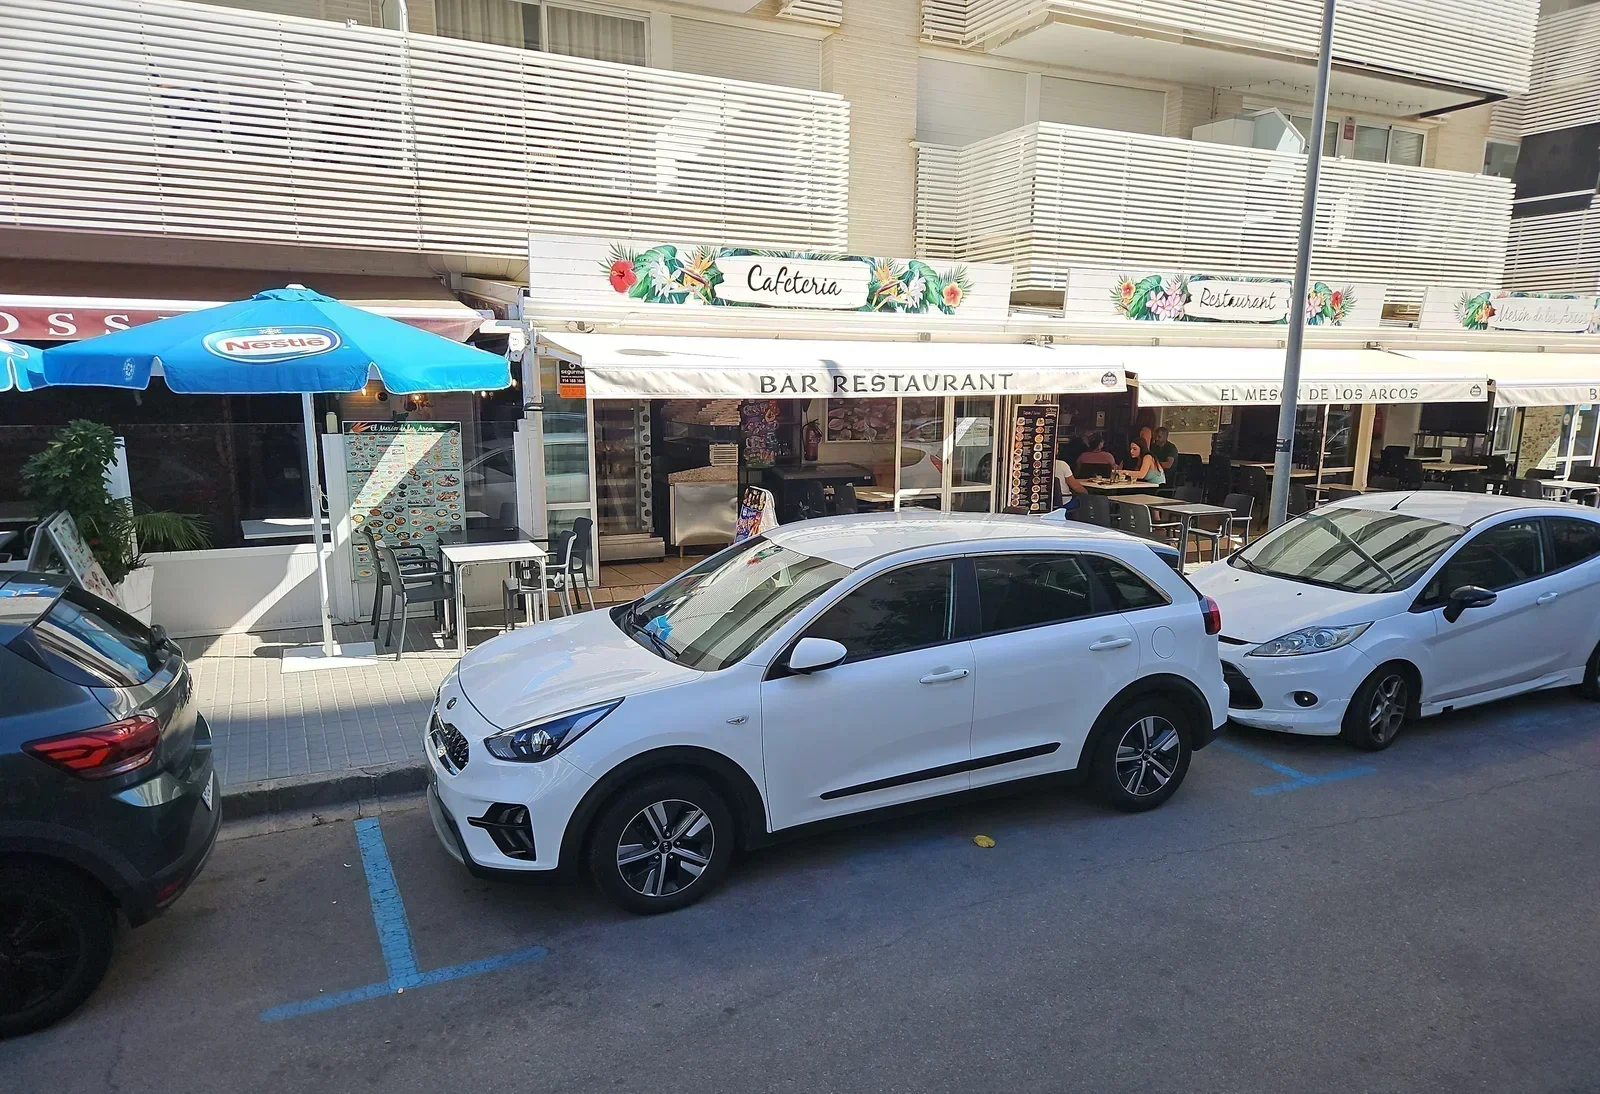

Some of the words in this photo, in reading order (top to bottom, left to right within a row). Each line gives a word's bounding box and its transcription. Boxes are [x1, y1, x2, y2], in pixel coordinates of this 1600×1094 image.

[747, 264, 842, 296] Cafeteria
[1199, 287, 1276, 310] Restaurant
[759, 375, 818, 394] BAR
[832, 372, 1014, 394] RESTAURANT
[1220, 388, 1239, 401] EL
[1309, 387, 1329, 400] DE
[1335, 387, 1363, 400] LOS
[1368, 387, 1419, 400] ARCOS
